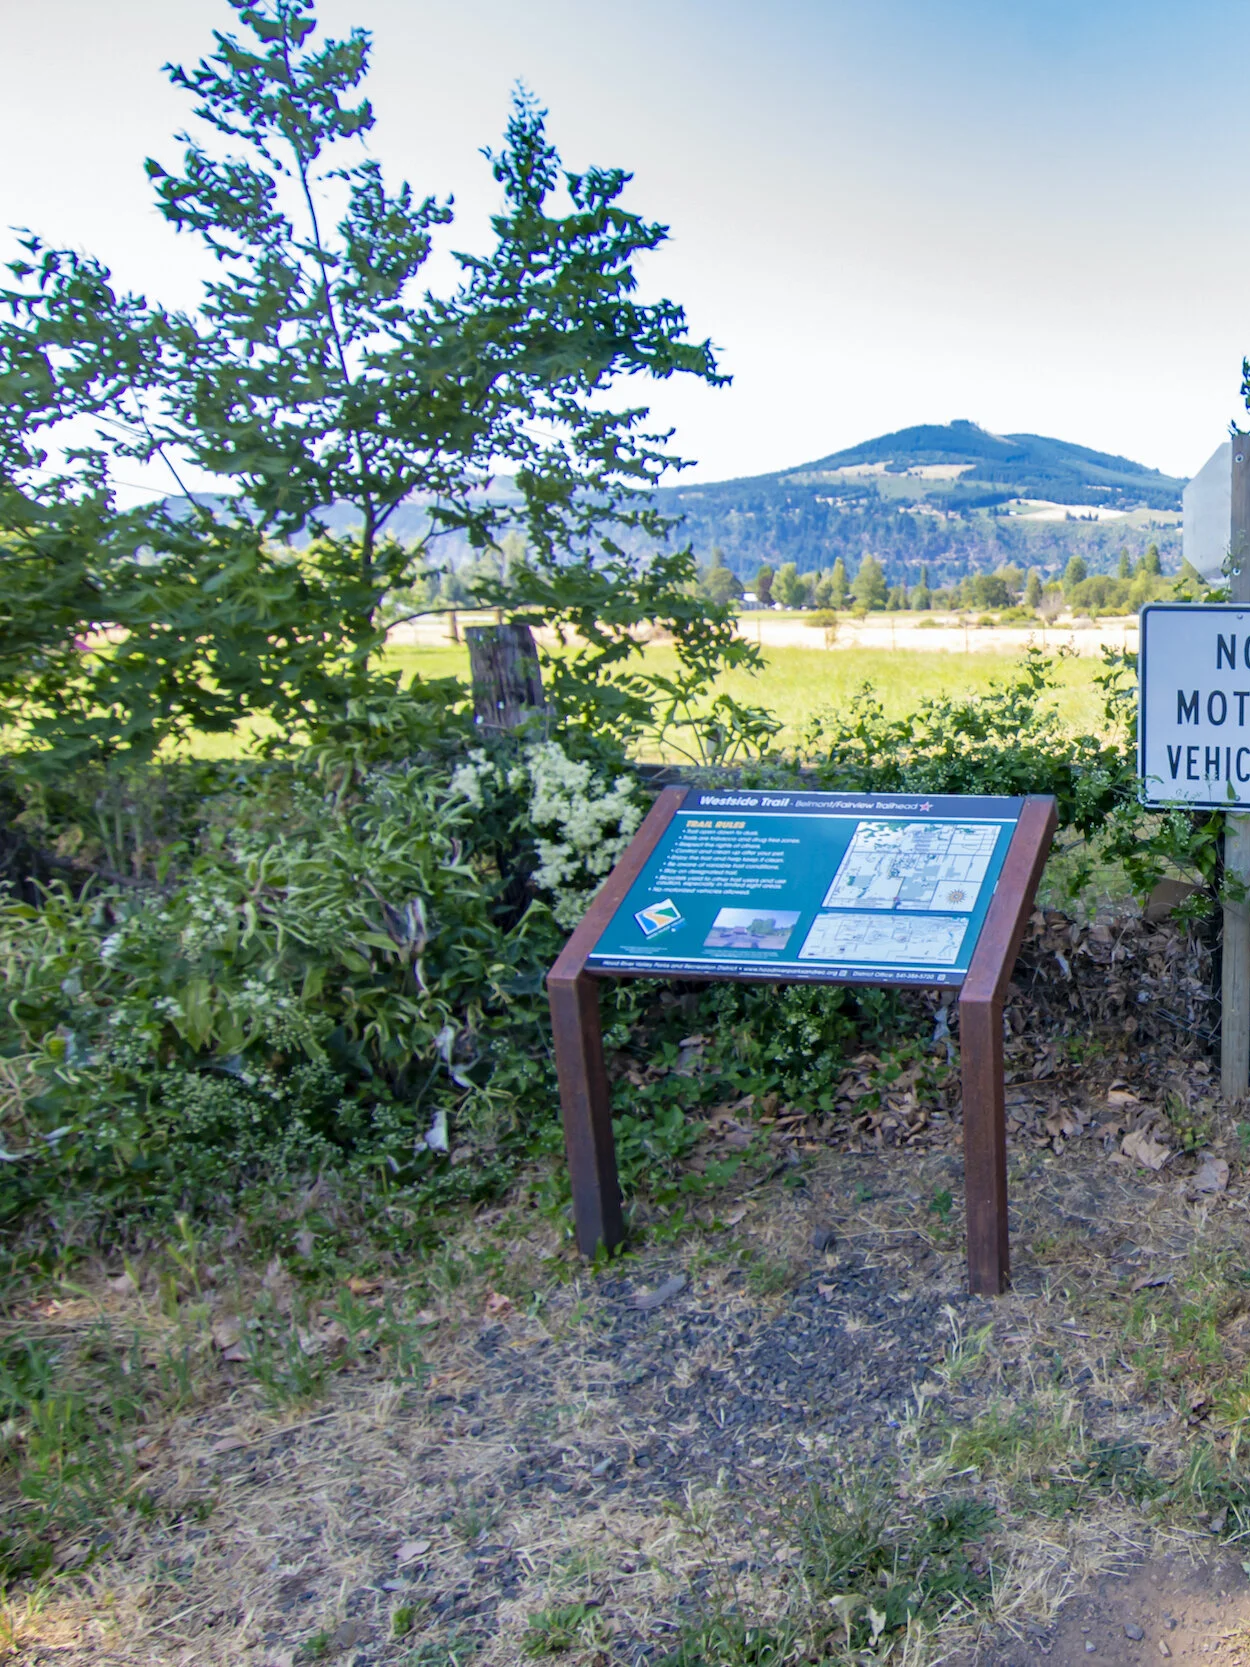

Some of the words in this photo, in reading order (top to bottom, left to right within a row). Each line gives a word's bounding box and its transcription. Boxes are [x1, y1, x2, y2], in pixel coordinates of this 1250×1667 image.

[700, 796, 759, 806] Westside
[761, 797, 790, 807] Trail
[795, 800, 875, 809] Belmont/Fairview
[876, 801, 919, 810] Trailhead
[686, 820, 713, 828] TRAIL
[715, 821, 746, 829] RULES
